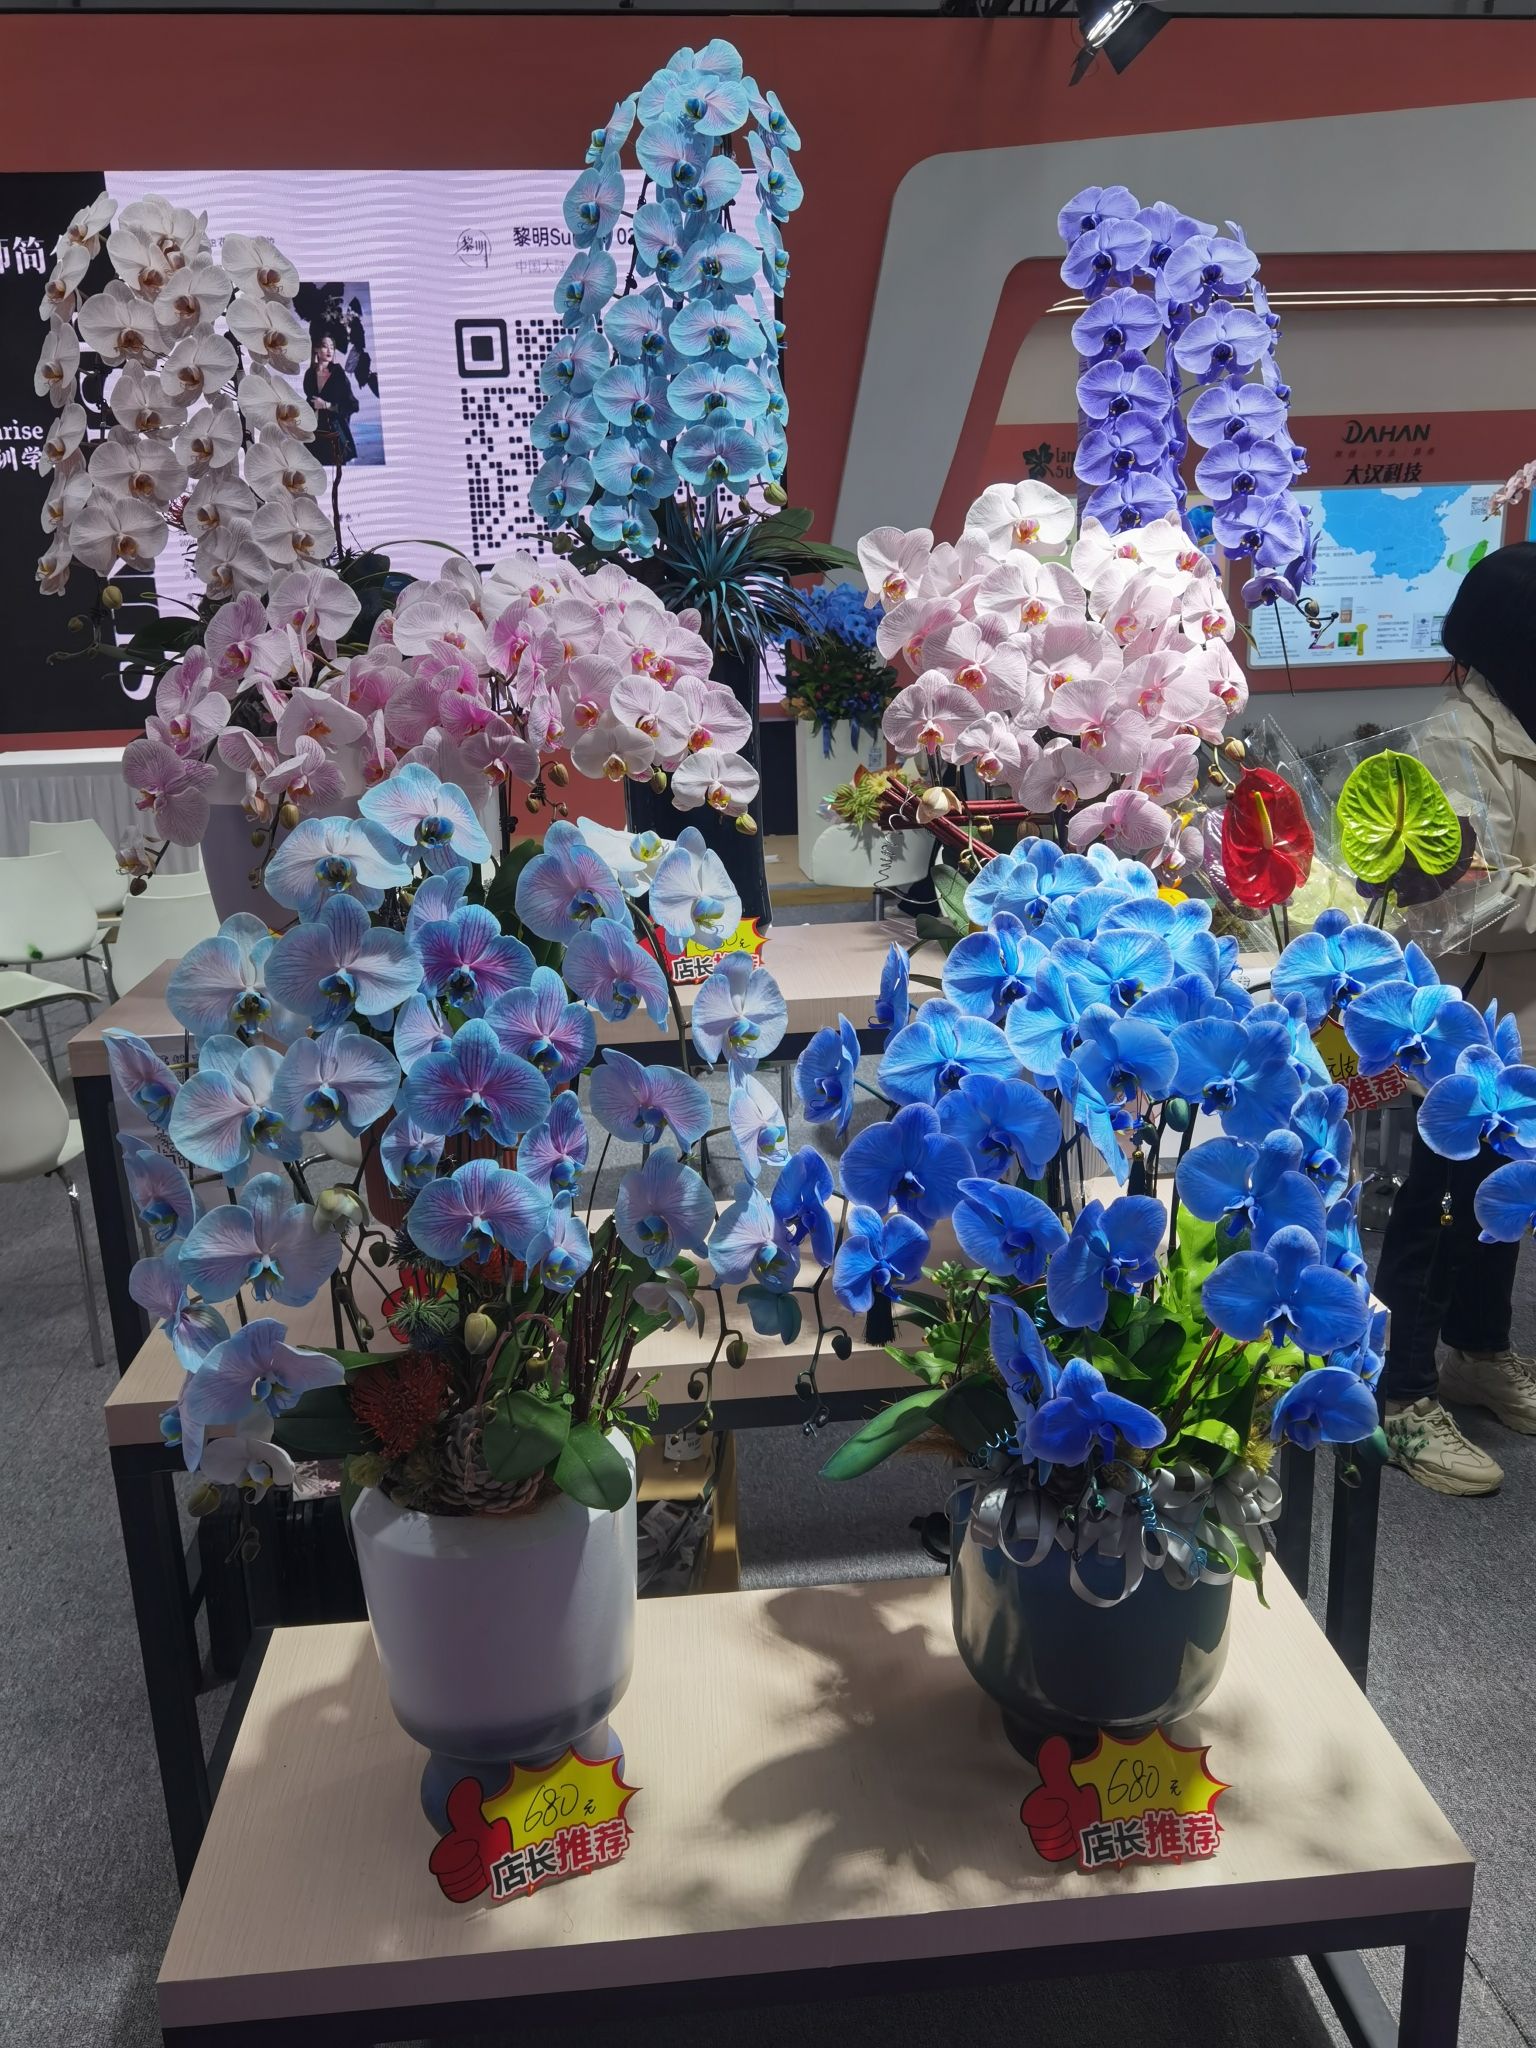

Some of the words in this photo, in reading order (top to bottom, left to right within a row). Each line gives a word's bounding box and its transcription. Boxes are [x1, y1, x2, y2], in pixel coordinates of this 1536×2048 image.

[1342, 420, 1431, 444] DAHAN
[1343, 462, 1423, 485] 大汉科技
[491, 1820, 625, 1896] 店长推荐
[1081, 1814, 1214, 1865] 店长推荐
